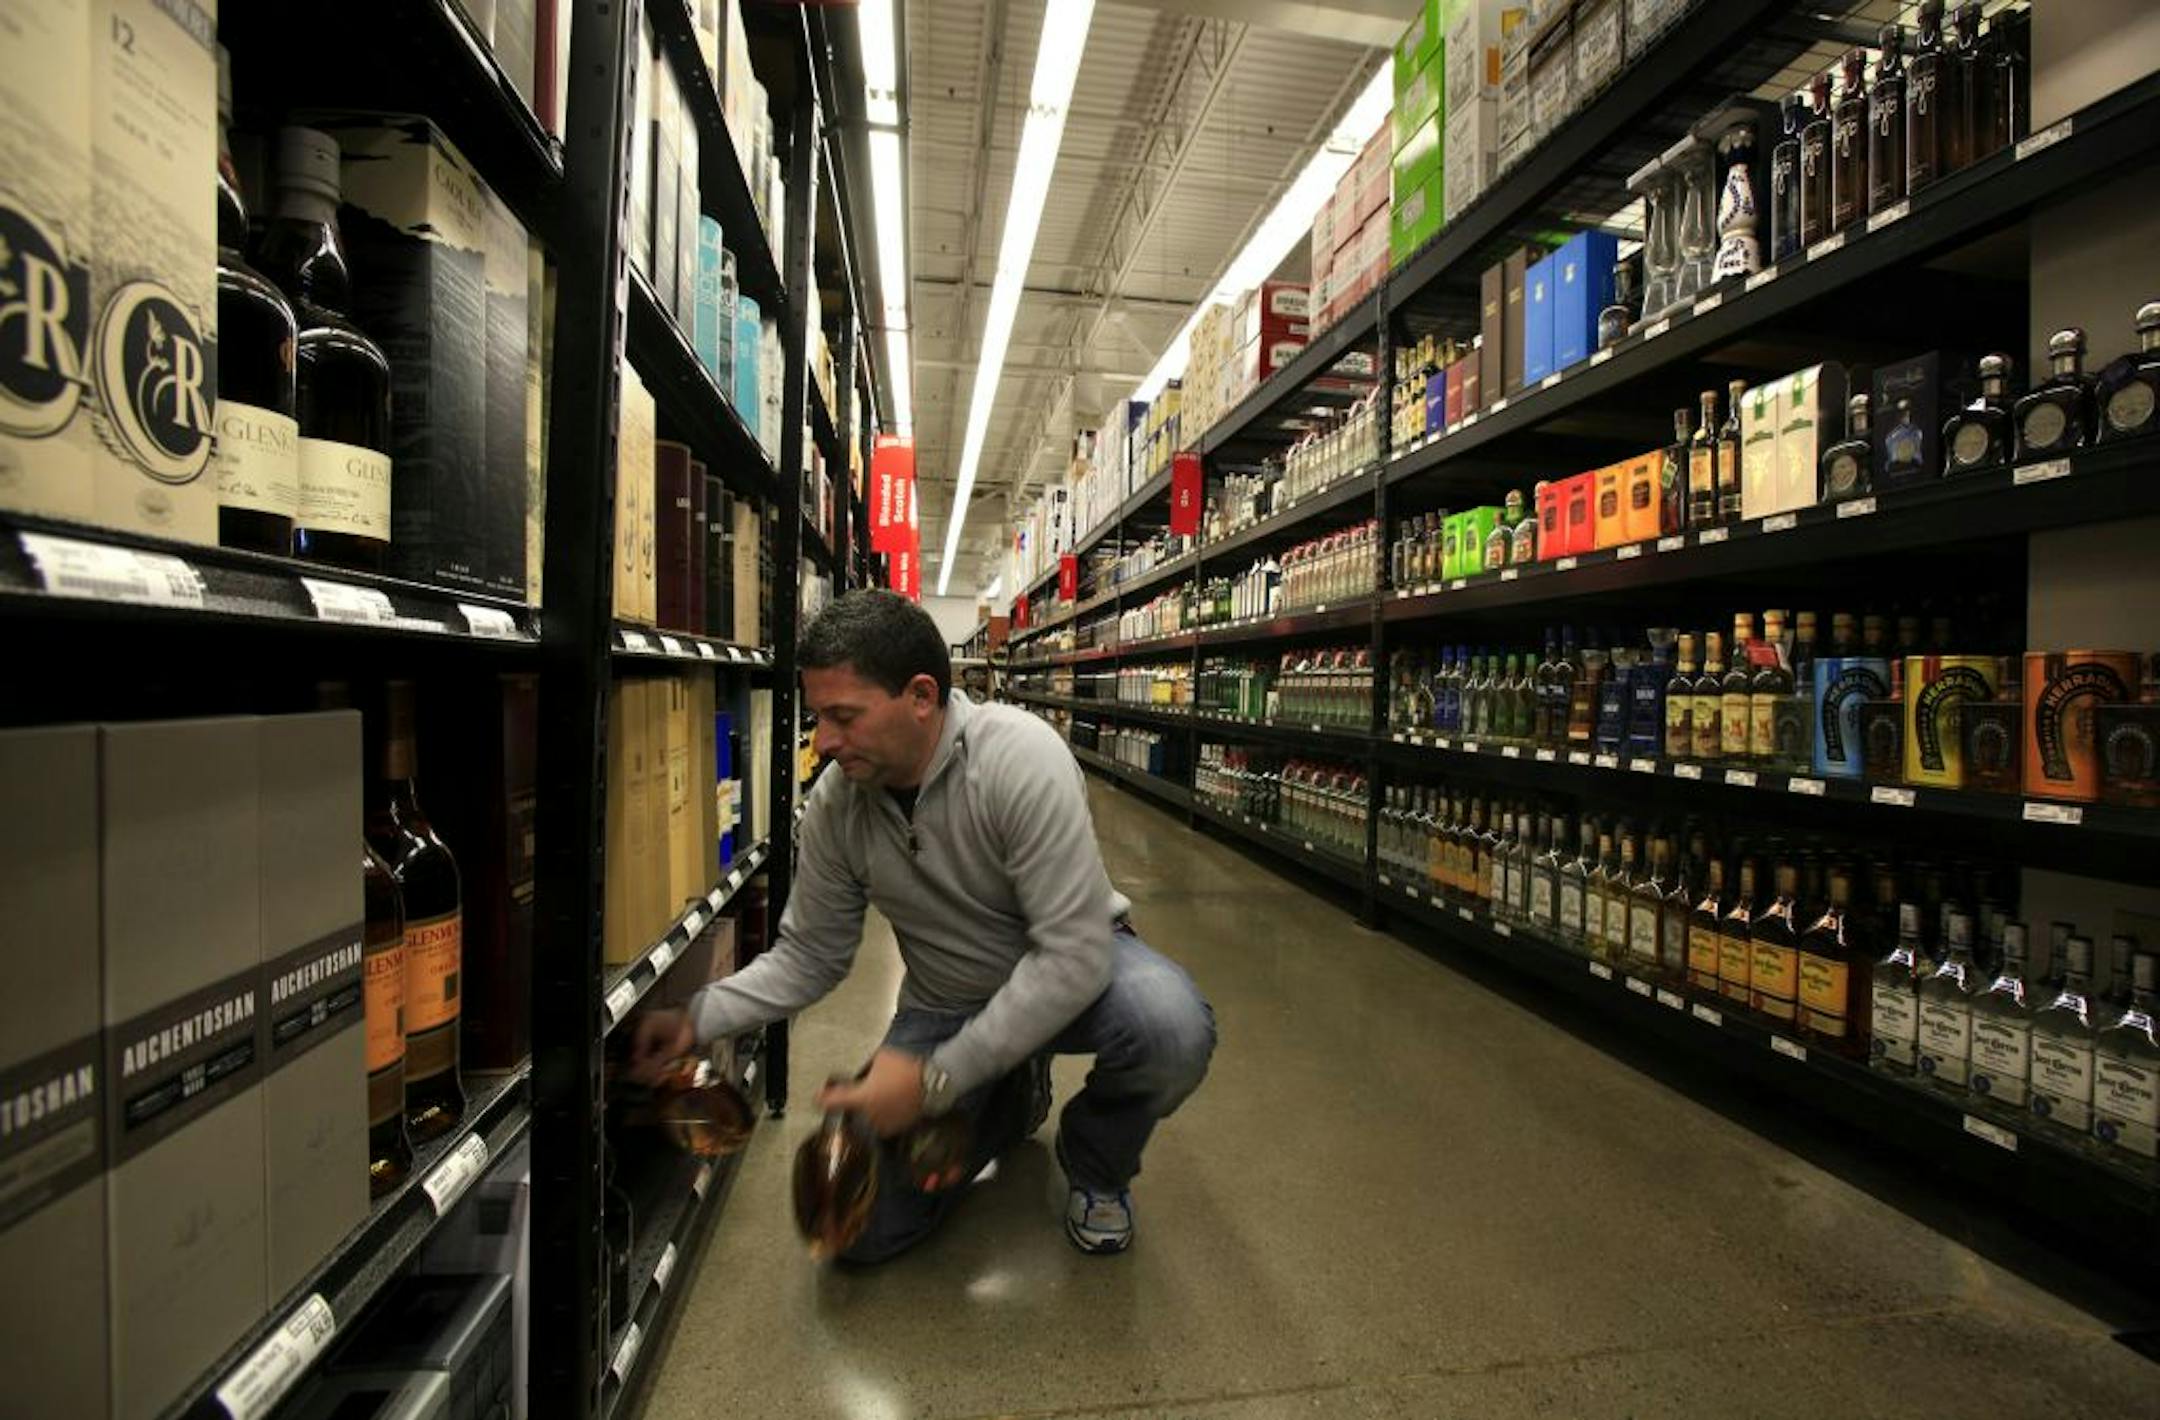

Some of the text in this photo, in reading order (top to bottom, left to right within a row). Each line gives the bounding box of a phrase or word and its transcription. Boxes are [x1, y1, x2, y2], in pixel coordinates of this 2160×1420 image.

[112, 13, 136, 56] 12
[271, 940, 362, 1006] AUCHENTOSHAN
[122, 989, 255, 1078] AUCHENTOSHAN
